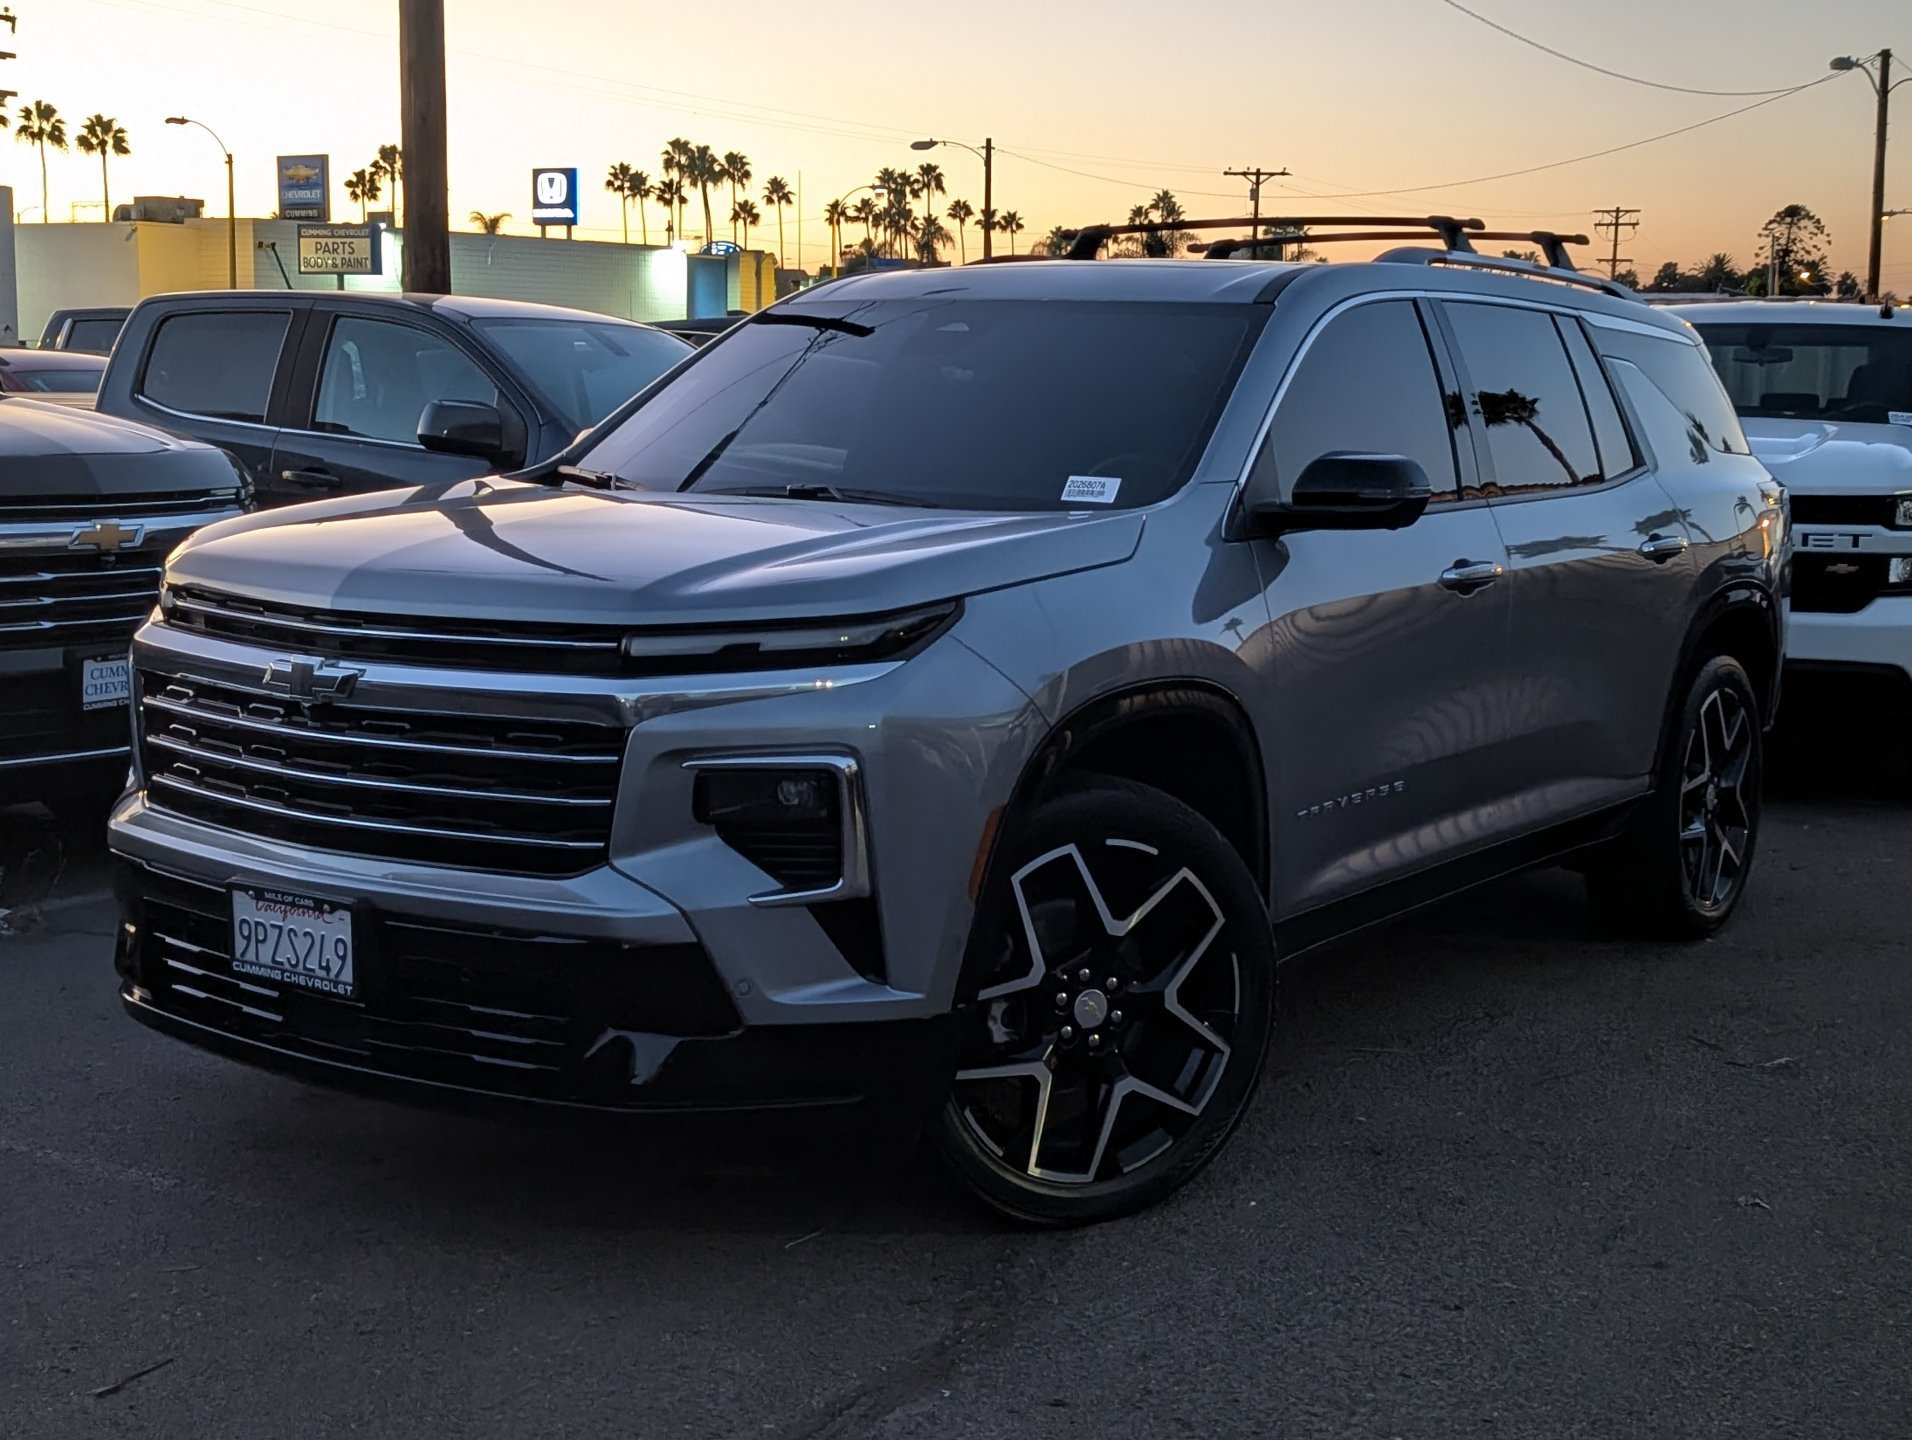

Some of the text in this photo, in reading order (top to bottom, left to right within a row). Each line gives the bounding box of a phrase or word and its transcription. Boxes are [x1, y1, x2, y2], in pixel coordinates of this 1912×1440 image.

[281, 190, 321, 199] CHEVROLET
[301, 228, 369, 236] CUMMING CHEVROLET
[314, 241, 355, 255] PARTS
[303, 257, 369, 269] BODY & PAINT
[1793, 532, 1873, 549] ET
[283, 894, 294, 903] OF
[238, 917, 348, 979] 9PZS249
[232, 961, 353, 996] CUMMING CHEVROLET
